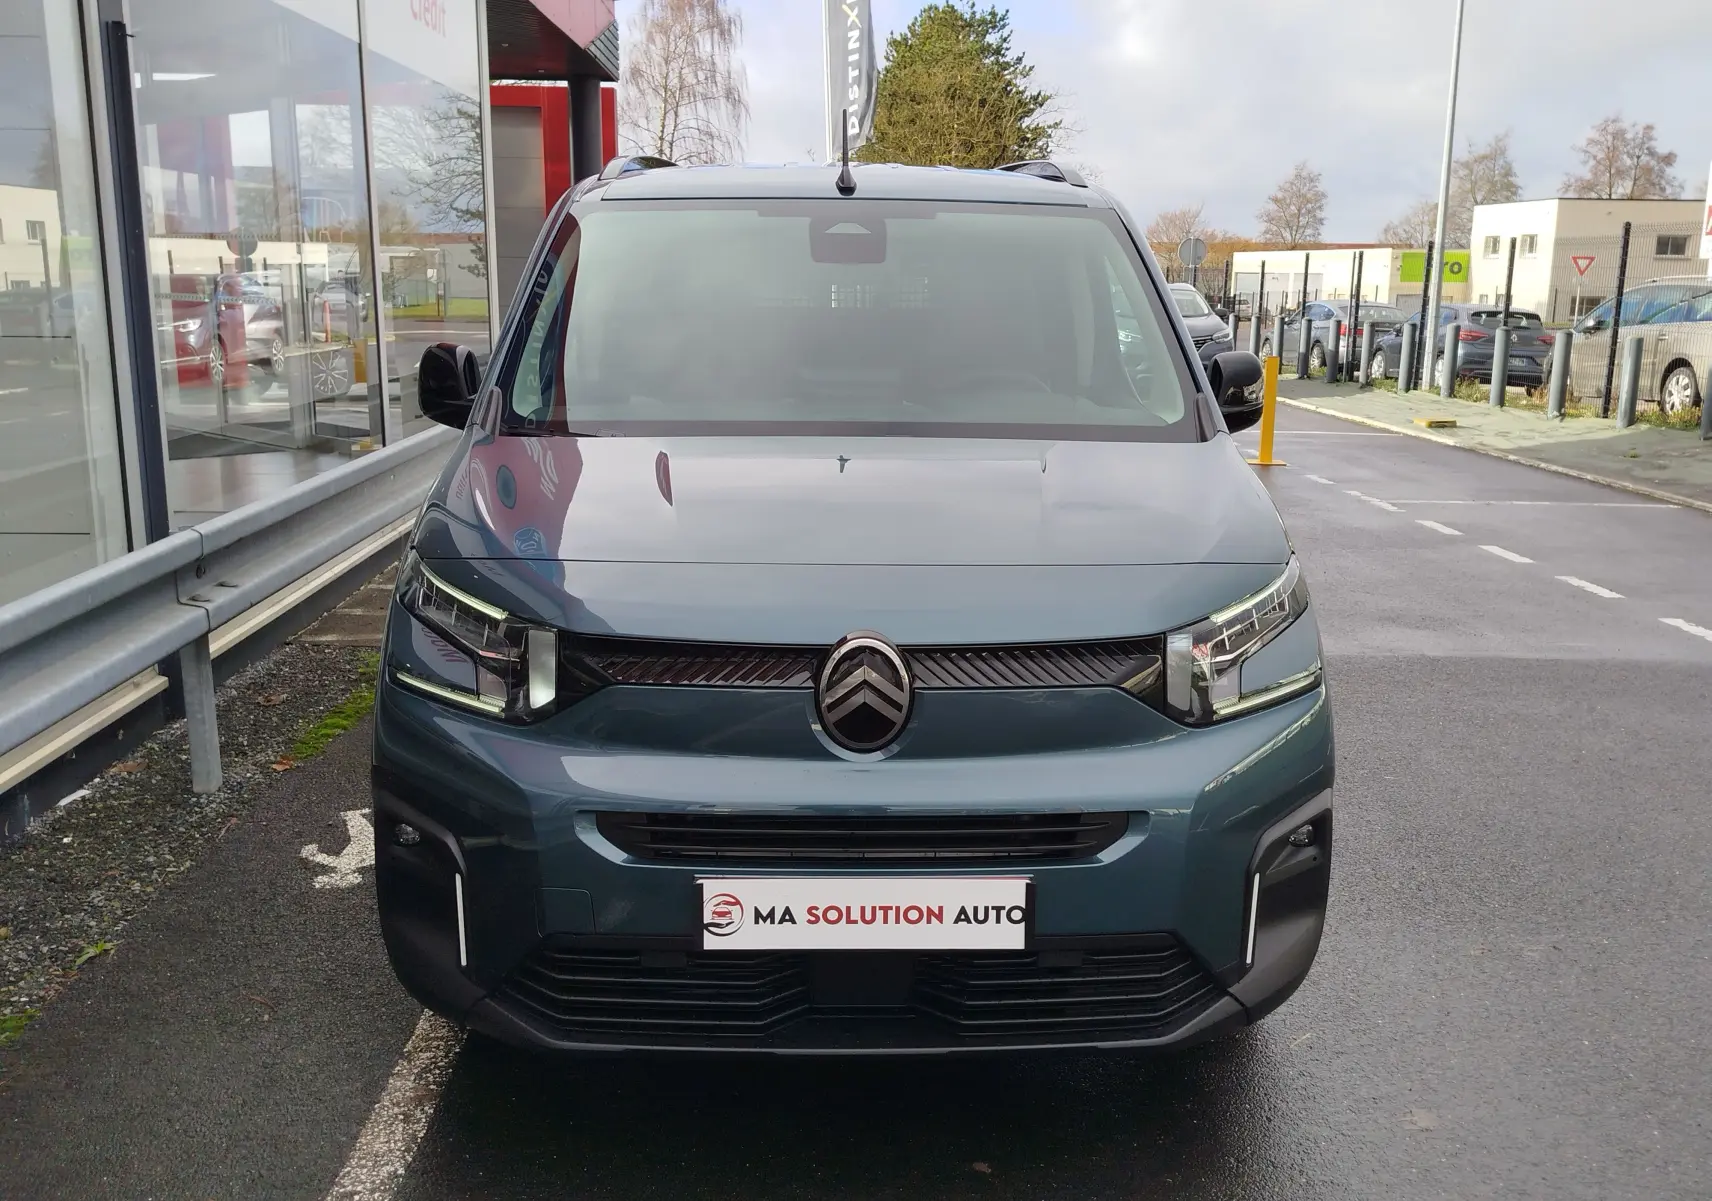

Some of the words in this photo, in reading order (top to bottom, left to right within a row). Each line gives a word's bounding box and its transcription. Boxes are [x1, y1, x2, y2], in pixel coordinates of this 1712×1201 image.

[753, 905, 797, 925] MA
[806, 905, 944, 925] SOLUTION
[953, 905, 1026, 925] AUTO
